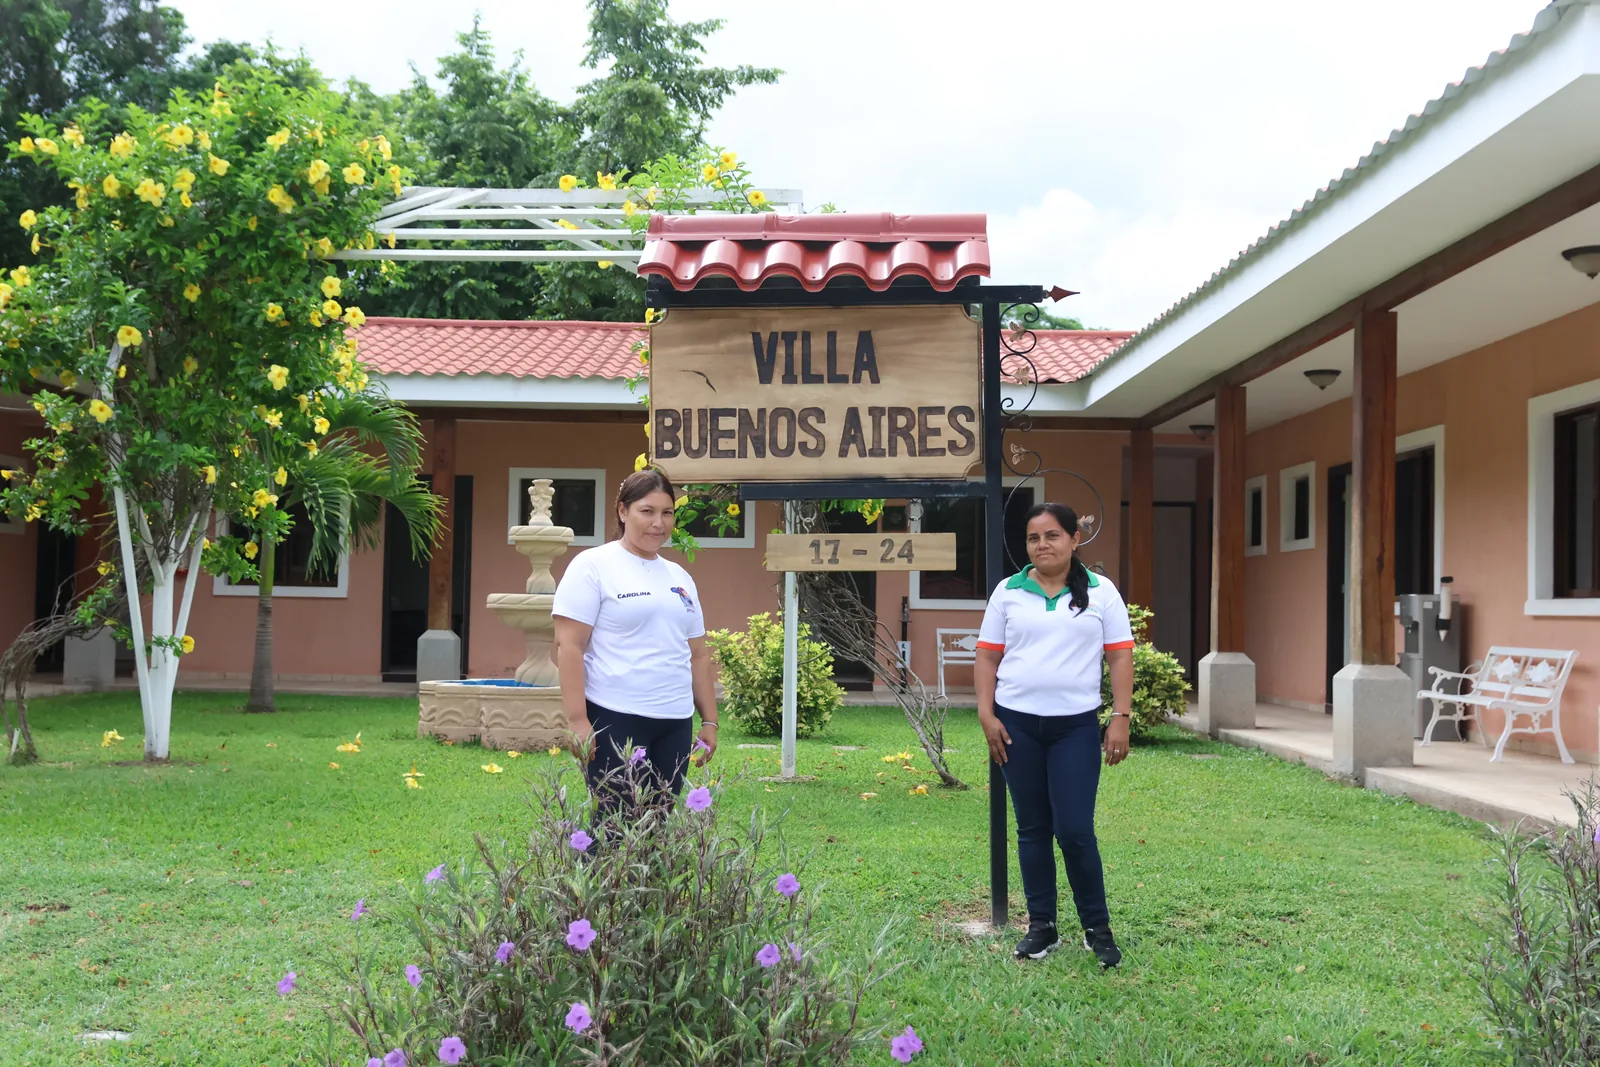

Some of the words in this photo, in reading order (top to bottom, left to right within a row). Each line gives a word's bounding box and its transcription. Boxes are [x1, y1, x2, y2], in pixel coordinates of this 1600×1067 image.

[752, 330, 881, 385] VILLA
[654, 406, 826, 459] BUENOS
[837, 405, 976, 458] AIRES
[809, 539, 841, 565] 17
[879, 538, 915, 564] 24
[617, 591, 651, 599] CAROLINA
